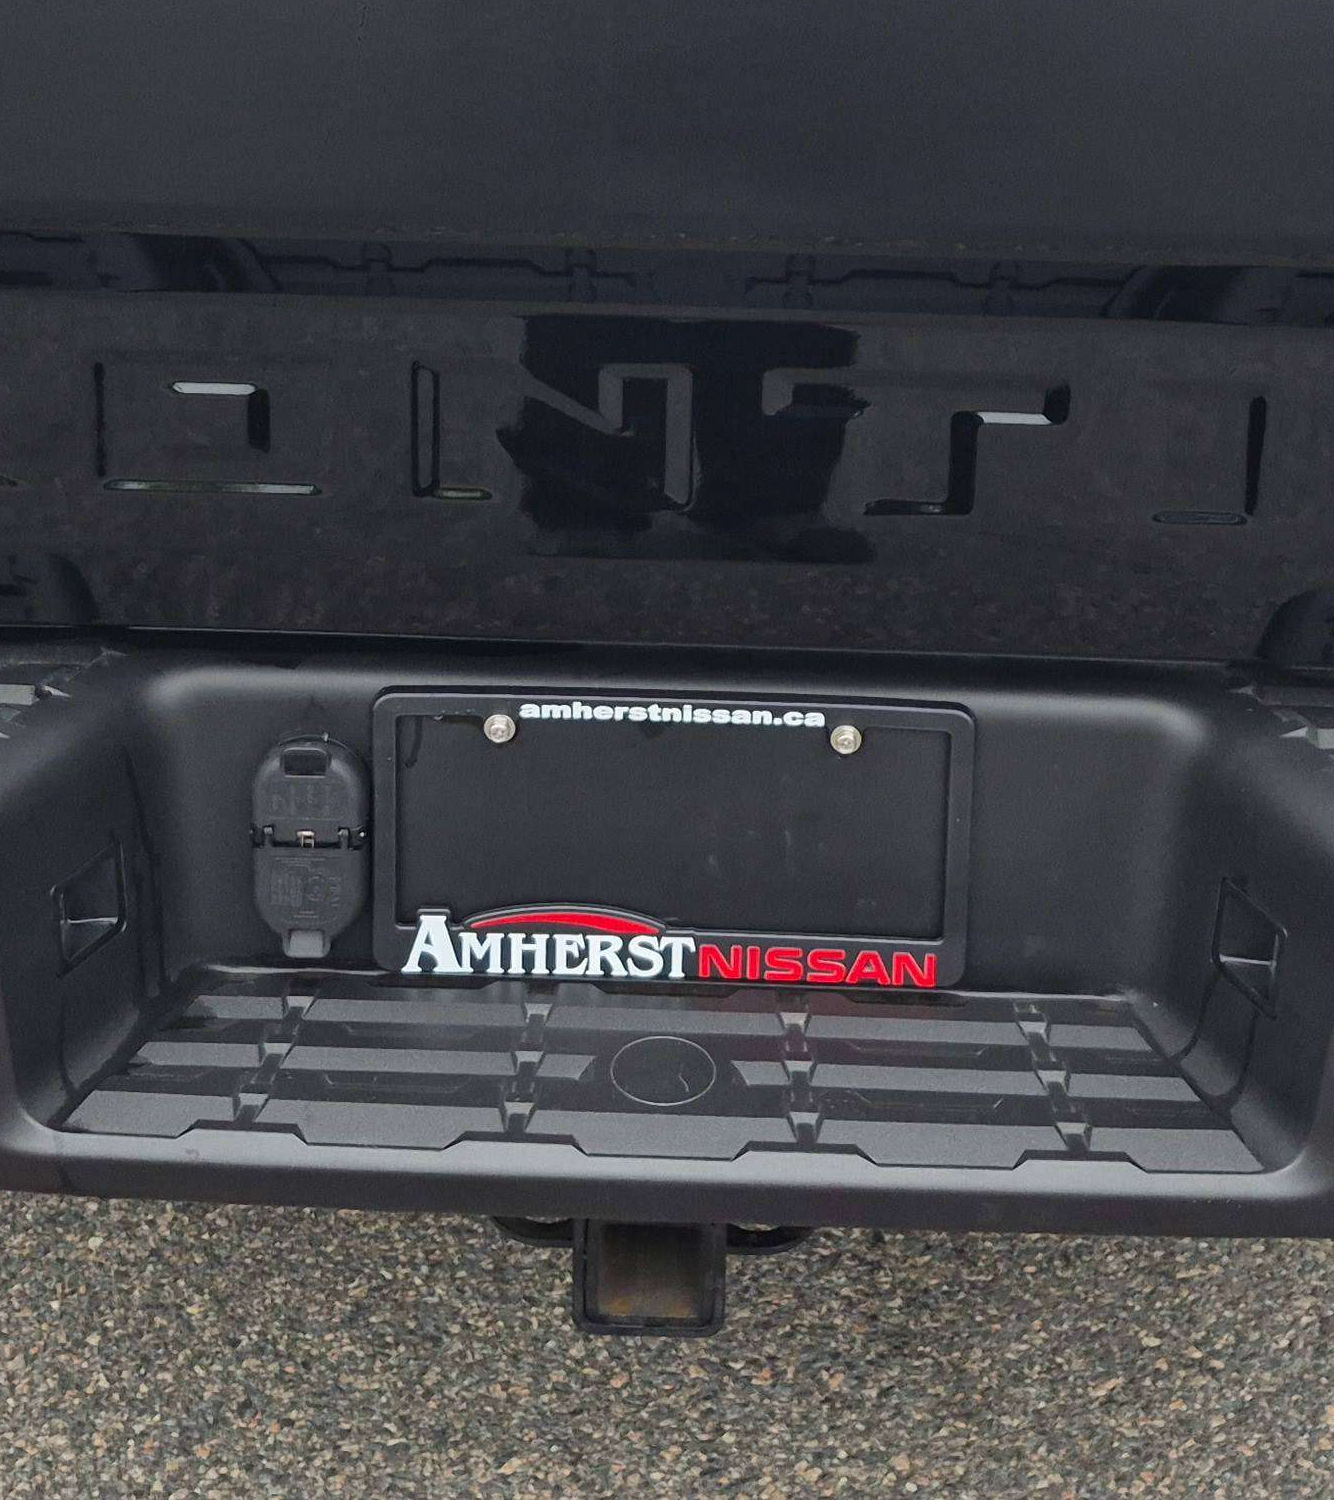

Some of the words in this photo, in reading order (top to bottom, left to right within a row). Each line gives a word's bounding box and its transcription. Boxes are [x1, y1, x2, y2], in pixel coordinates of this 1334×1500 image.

[519, 701, 826, 727] amherstnissan.ca
[401, 914, 696, 979] AMHERST
[698, 944, 938, 988] NISSAN
